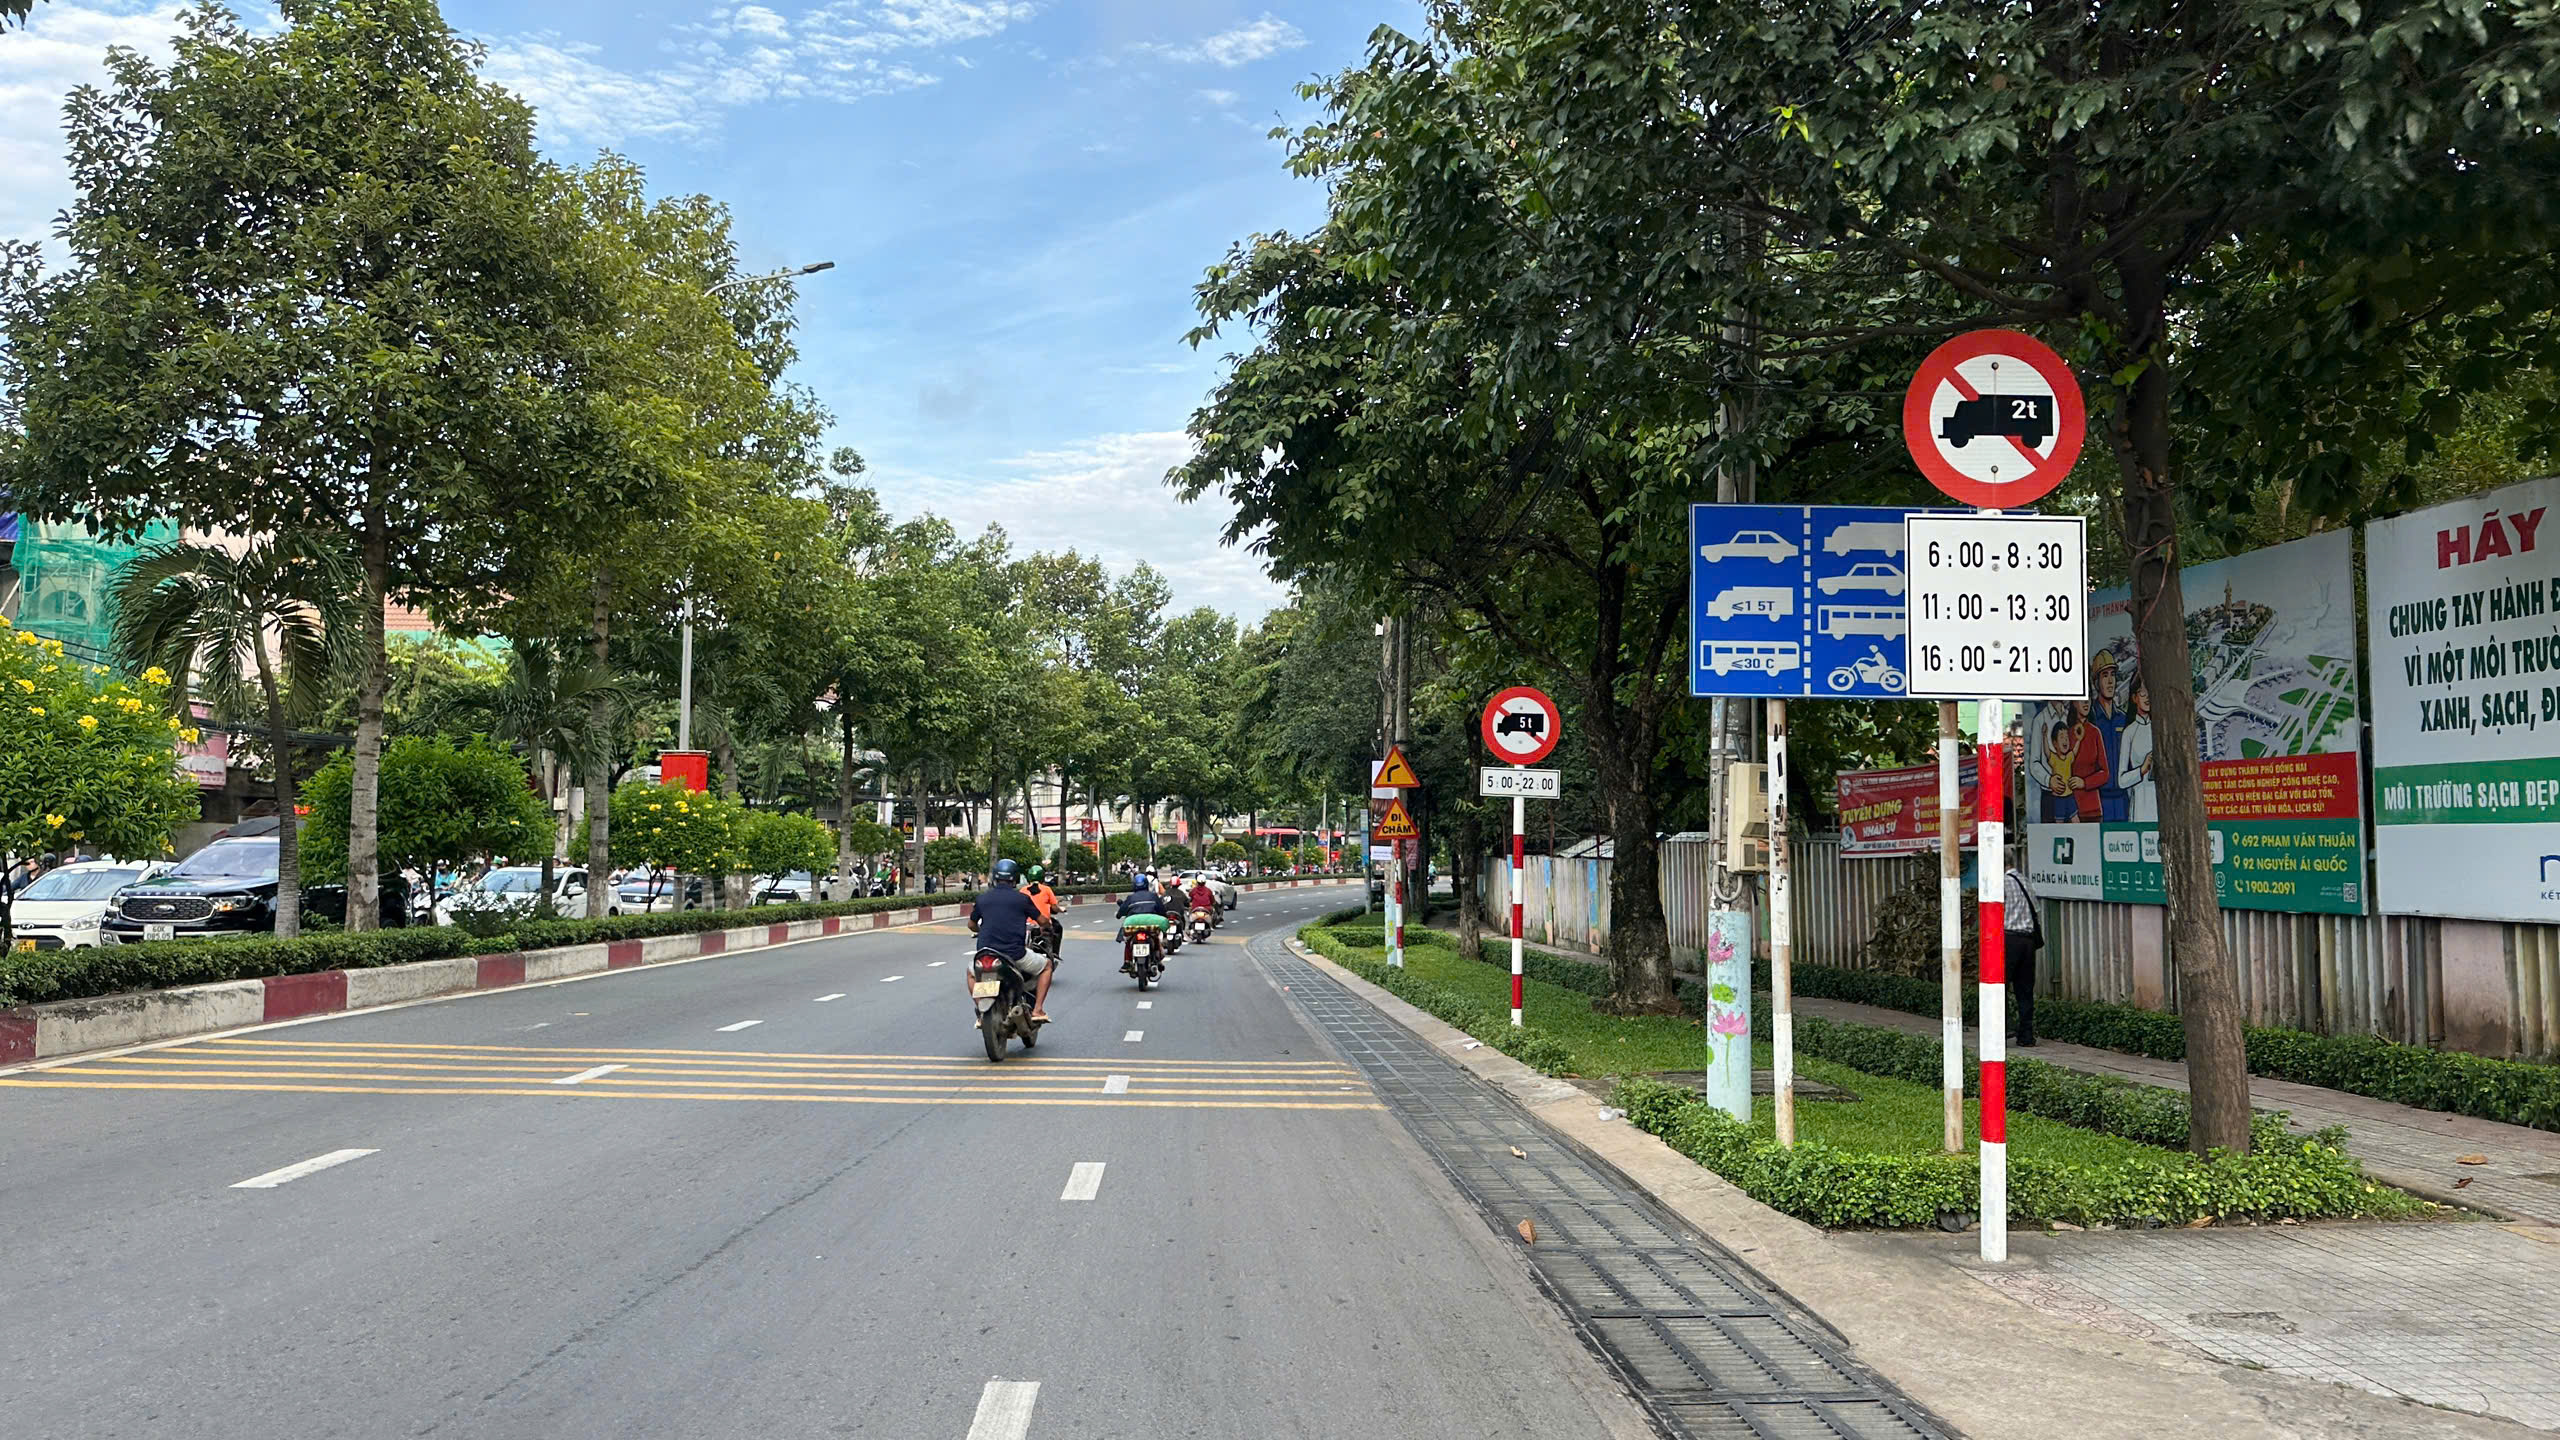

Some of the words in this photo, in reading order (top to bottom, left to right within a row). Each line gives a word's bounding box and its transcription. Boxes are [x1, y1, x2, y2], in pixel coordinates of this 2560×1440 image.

[2011, 399, 2038, 419] 2t
[2437, 506, 2547, 569] HÃY
[2389, 598, 2447, 638] CHUNG
[2452, 591, 2484, 628] TAY
[2490, 576, 2544, 623] HÀNH
[2404, 645, 2422, 687] VÌ
[2428, 641, 2465, 691] MỘT
[2470, 634, 2506, 680] MÔI
[2420, 696, 2477, 735] XANH,
[2482, 690, 2536, 735] SẠCH,
[2384, 782, 2411, 810] MÔI
[2416, 779, 2472, 809] TRƯỜNG
[2478, 781, 2520, 812] SẠCH
[2526, 780, 2559, 811] ĐẸP
[1391, 813, 1401, 822] ĐI
[2242, 834, 2259, 847] 692
[2261, 834, 2290, 850] PHẠM
[2294, 832, 2316, 847] VĂN
[2319, 831, 2355, 851] THUẬN
[2243, 858, 2254, 870] 92
[2256, 853, 2297, 871] NGUYỄN
[2300, 856, 2311, 871] ÁI
[2313, 854, 2348, 872] QUỐC
[2031, 870, 2056, 884] HOÀNG
[2057, 871, 2068, 885] HÀ
[2070, 874, 2099, 886] MOBILE
[2245, 880, 2296, 894] 1900.2091
